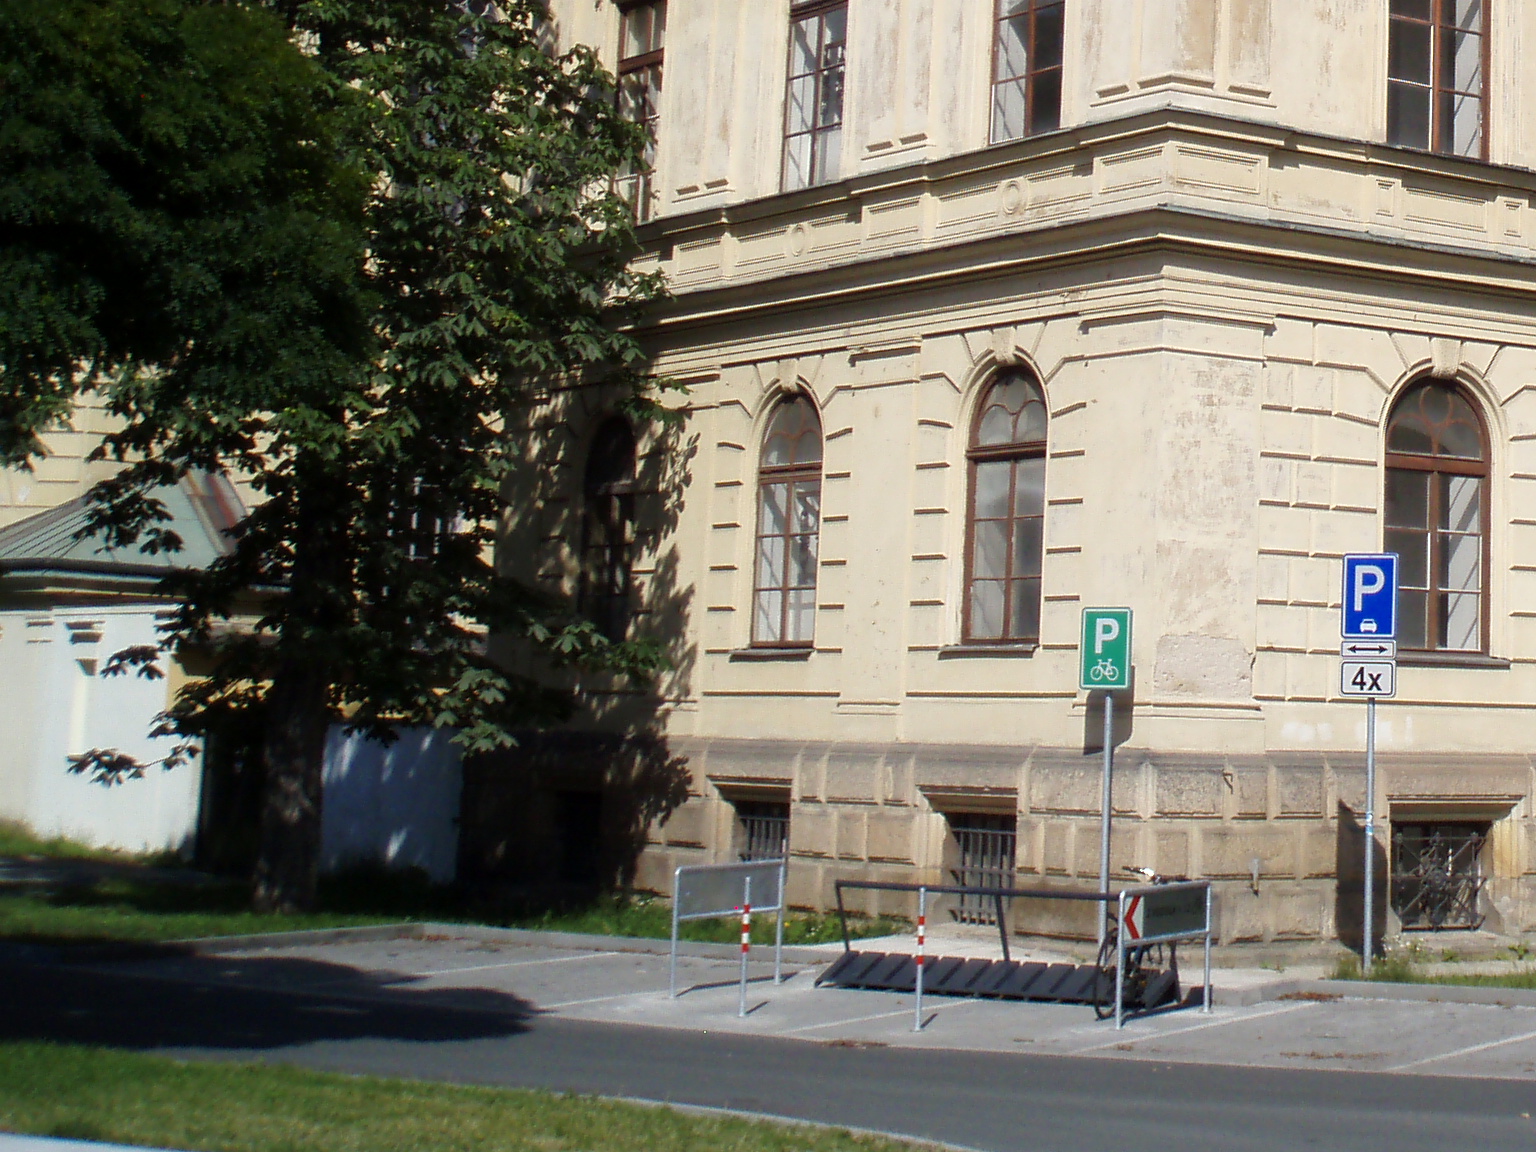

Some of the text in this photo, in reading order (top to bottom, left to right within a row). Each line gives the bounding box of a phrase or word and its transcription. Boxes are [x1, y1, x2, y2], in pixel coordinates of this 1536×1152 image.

[1354, 565, 1385, 611] P
[1094, 618, 1120, 654] P
[1351, 666, 1382, 692] 4x
